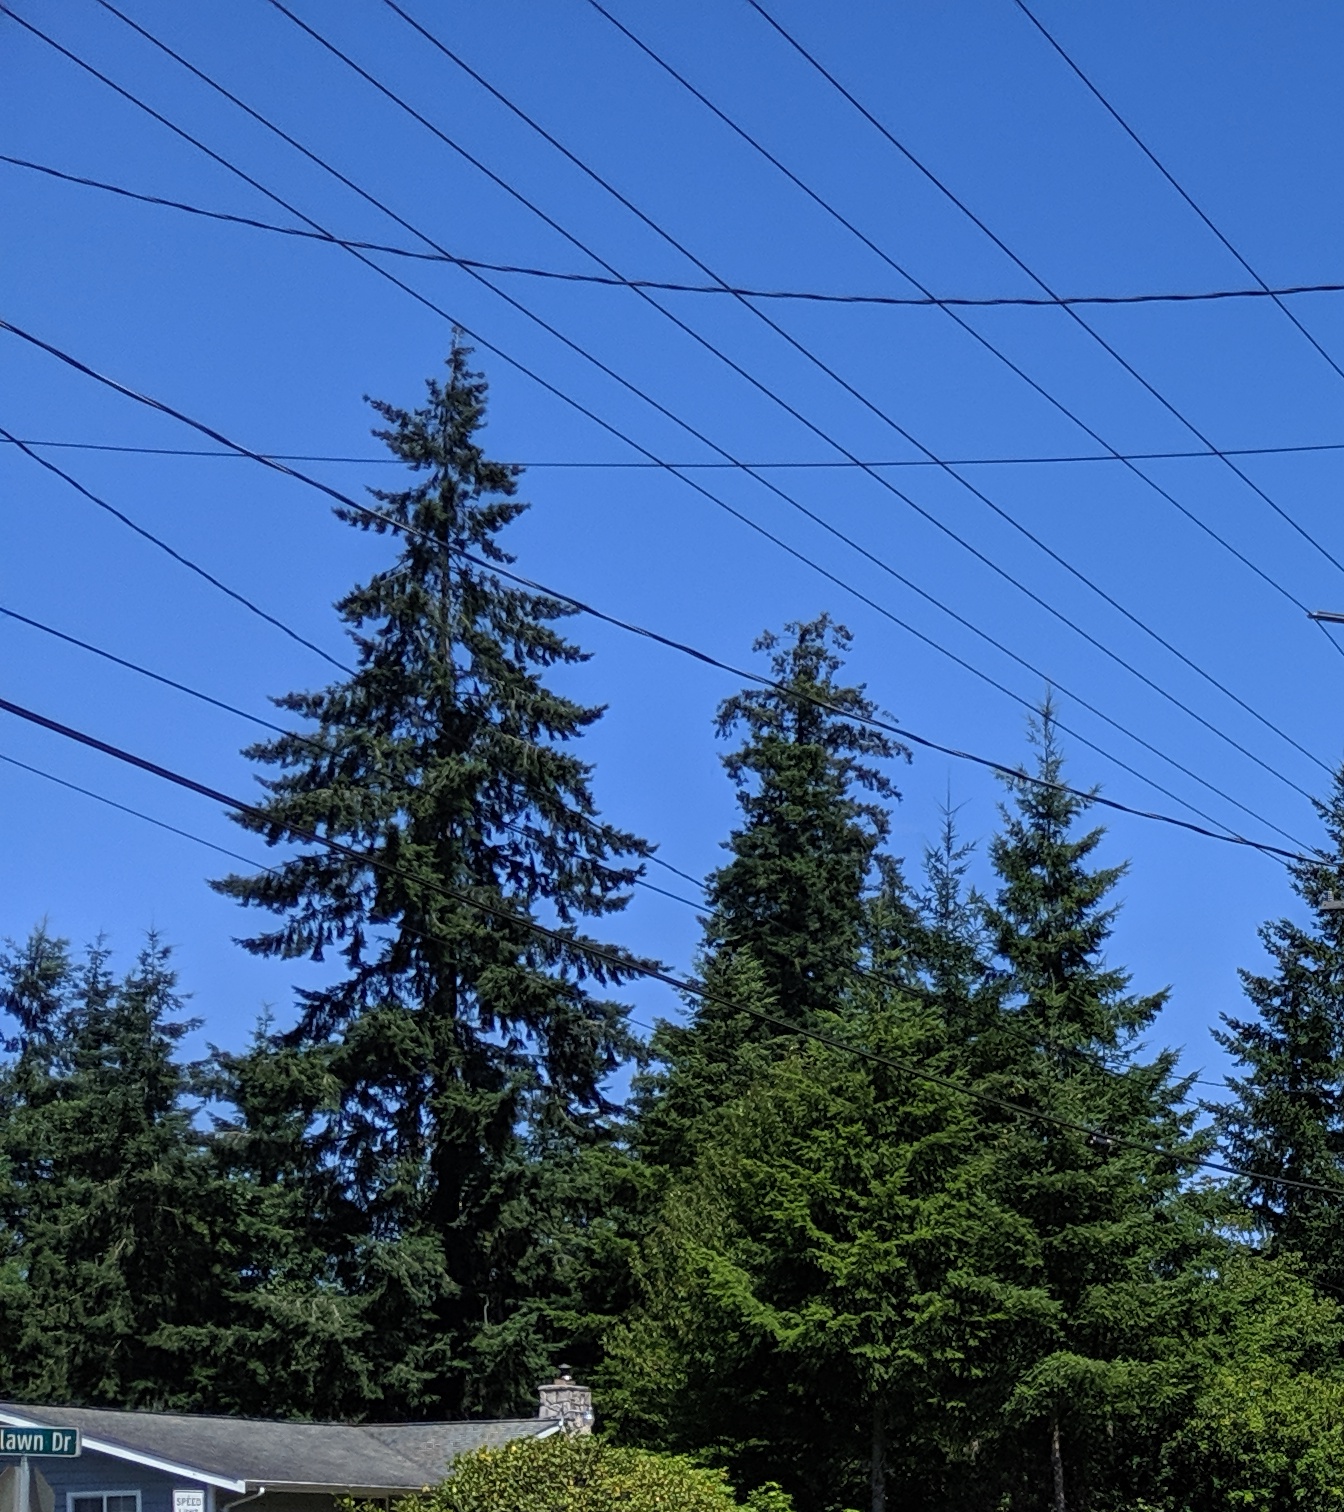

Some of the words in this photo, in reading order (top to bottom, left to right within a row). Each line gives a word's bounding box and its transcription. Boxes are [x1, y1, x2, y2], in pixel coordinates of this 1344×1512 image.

[0, 1429, 44, 1452] lawn
[52, 1431, 72, 1452] Dr
[176, 1497, 202, 1507] SPEED
